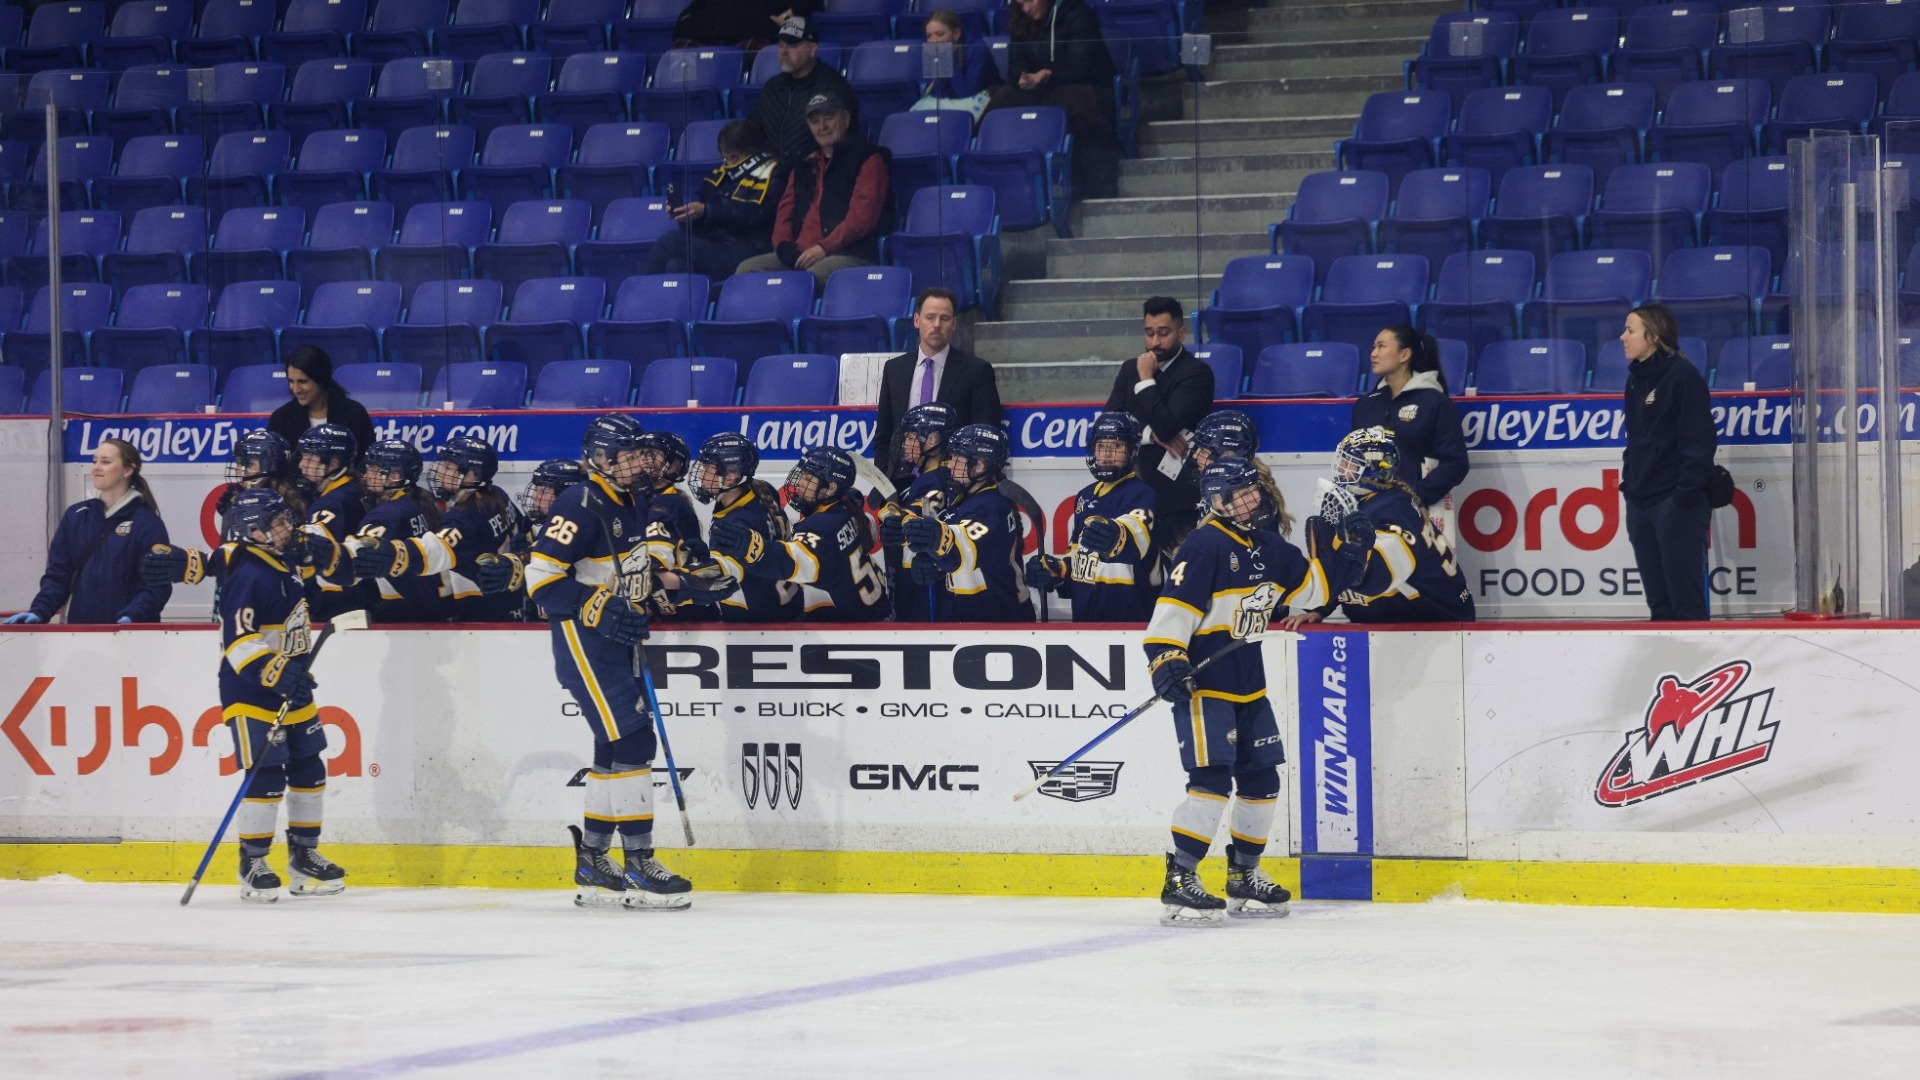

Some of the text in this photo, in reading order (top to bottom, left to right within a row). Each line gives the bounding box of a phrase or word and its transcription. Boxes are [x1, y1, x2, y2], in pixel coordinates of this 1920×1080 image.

[741, 409, 1101, 458] Langley Cen
[357, 522, 387, 538] 14
[545, 515, 578, 545] 26
[849, 545, 887, 606] 5
[1170, 561, 1188, 586] 4
[1479, 568, 1584, 597] FOOD
[1598, 566, 1757, 596] SECE
[234, 606, 257, 637] 19
[642, 644, 1125, 690] RESTON
[758, 702, 844, 717] BUICK
[880, 702, 949, 717] GMC
[984, 703, 1128, 719] CADILLAC
[0, 676, 362, 777] Kuba
[305, 722, 323, 735] CC
[1628, 688, 1779, 788] WHL
[849, 764, 980, 791] GMC
